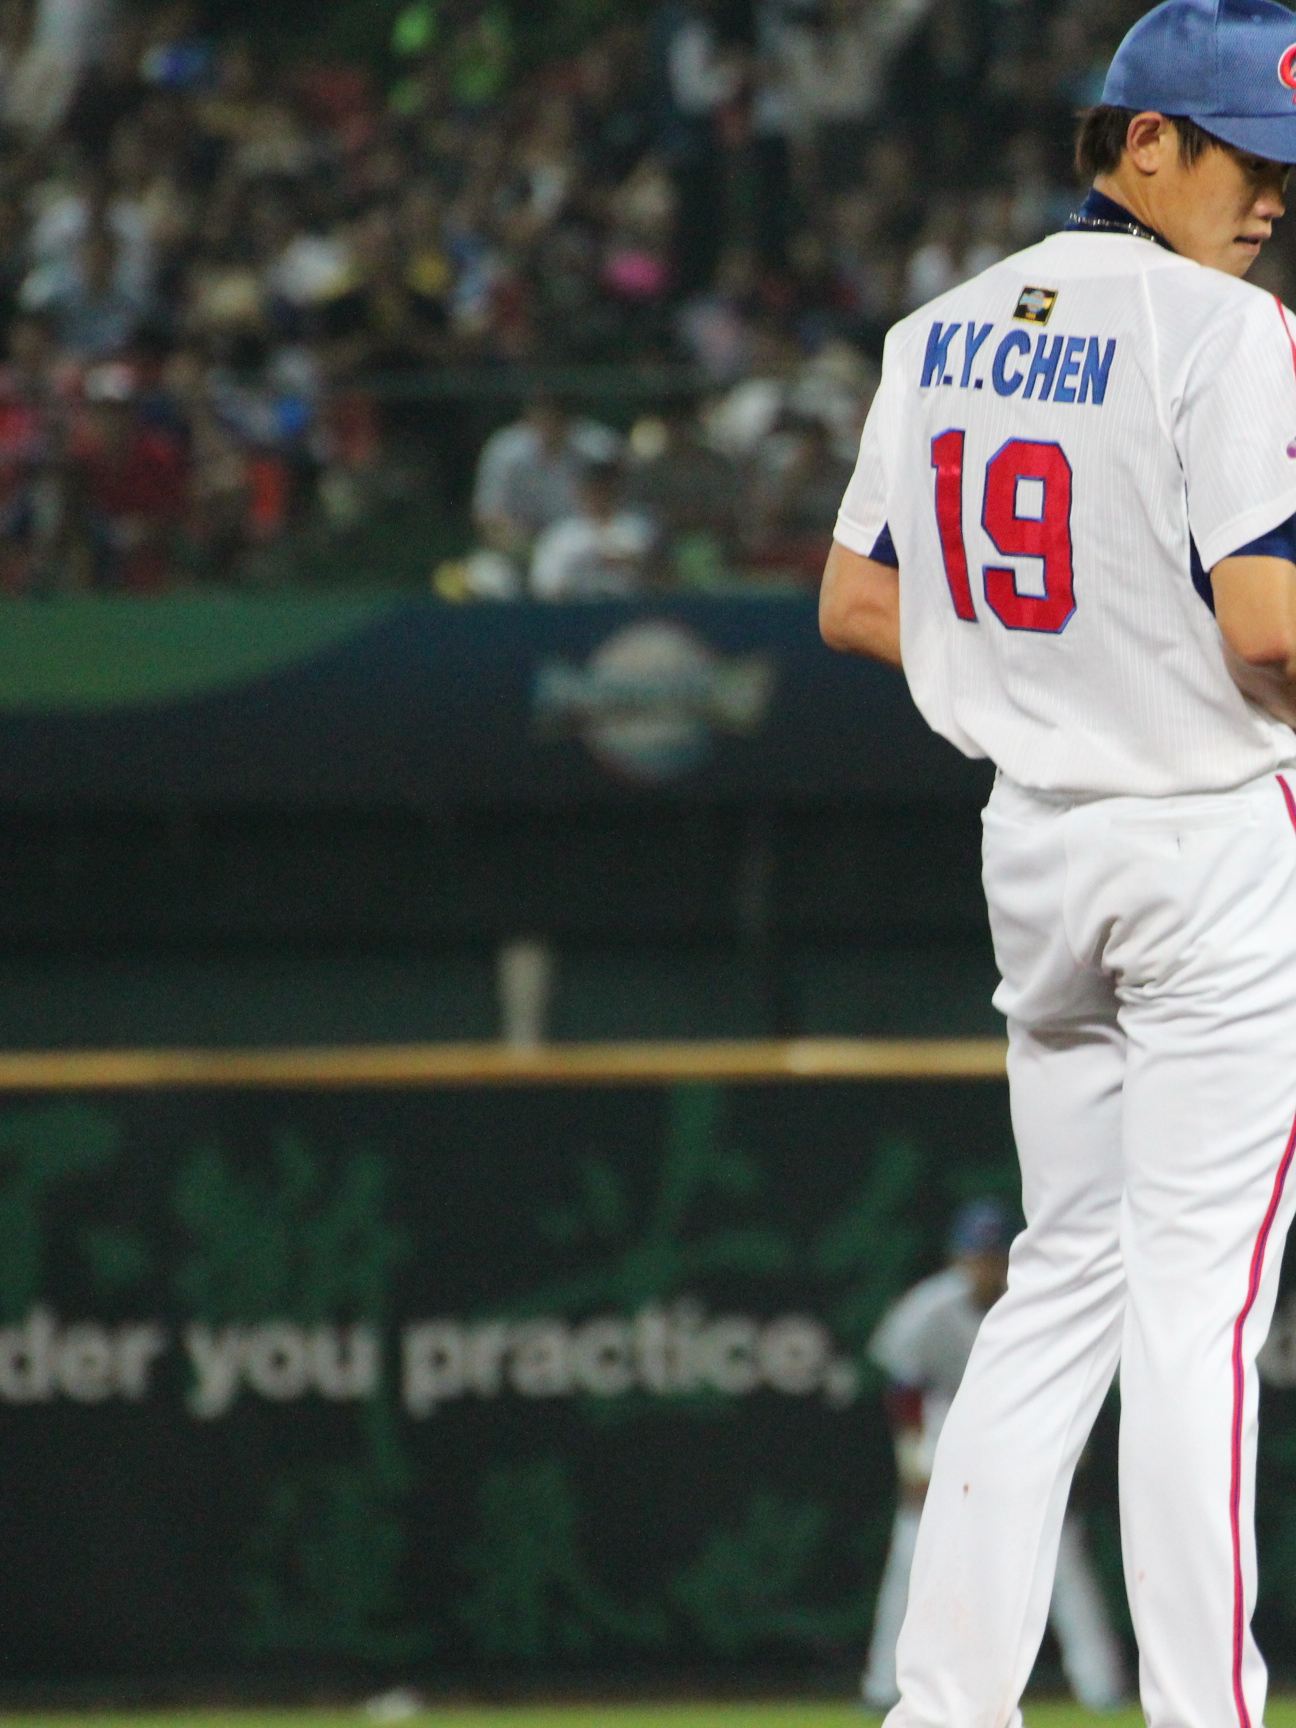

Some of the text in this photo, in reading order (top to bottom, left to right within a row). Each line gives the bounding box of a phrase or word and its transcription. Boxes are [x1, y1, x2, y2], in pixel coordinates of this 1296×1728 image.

[920, 321, 1117, 406] K.Y.CHEN
[931, 427, 1077, 635] 19
[186, 1323, 379, 1417] you
[403, 1302, 857, 1413] practice,
